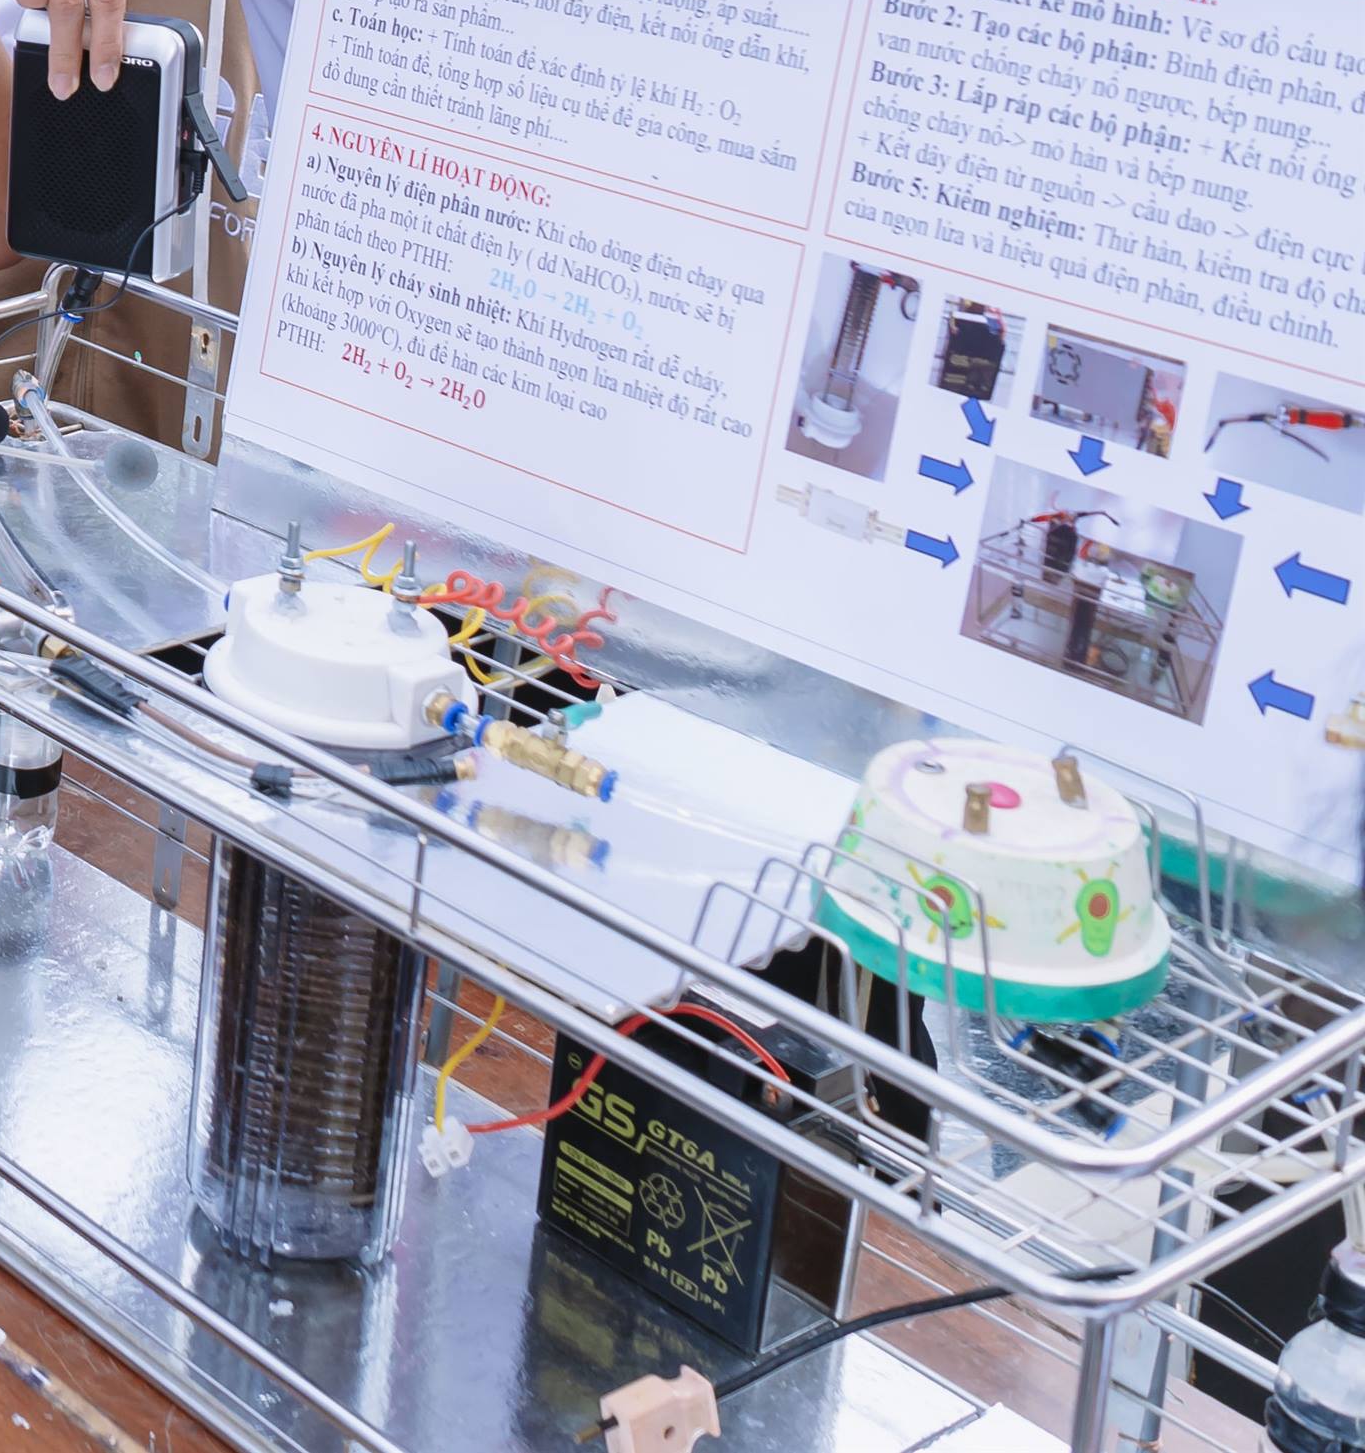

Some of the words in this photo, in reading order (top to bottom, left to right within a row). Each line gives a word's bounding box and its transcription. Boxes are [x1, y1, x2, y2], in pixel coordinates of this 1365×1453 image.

[573, 1078, 636, 1139] GS
[645, 1228, 672, 1258] Pb
[701, 1263, 729, 1294] Pb
